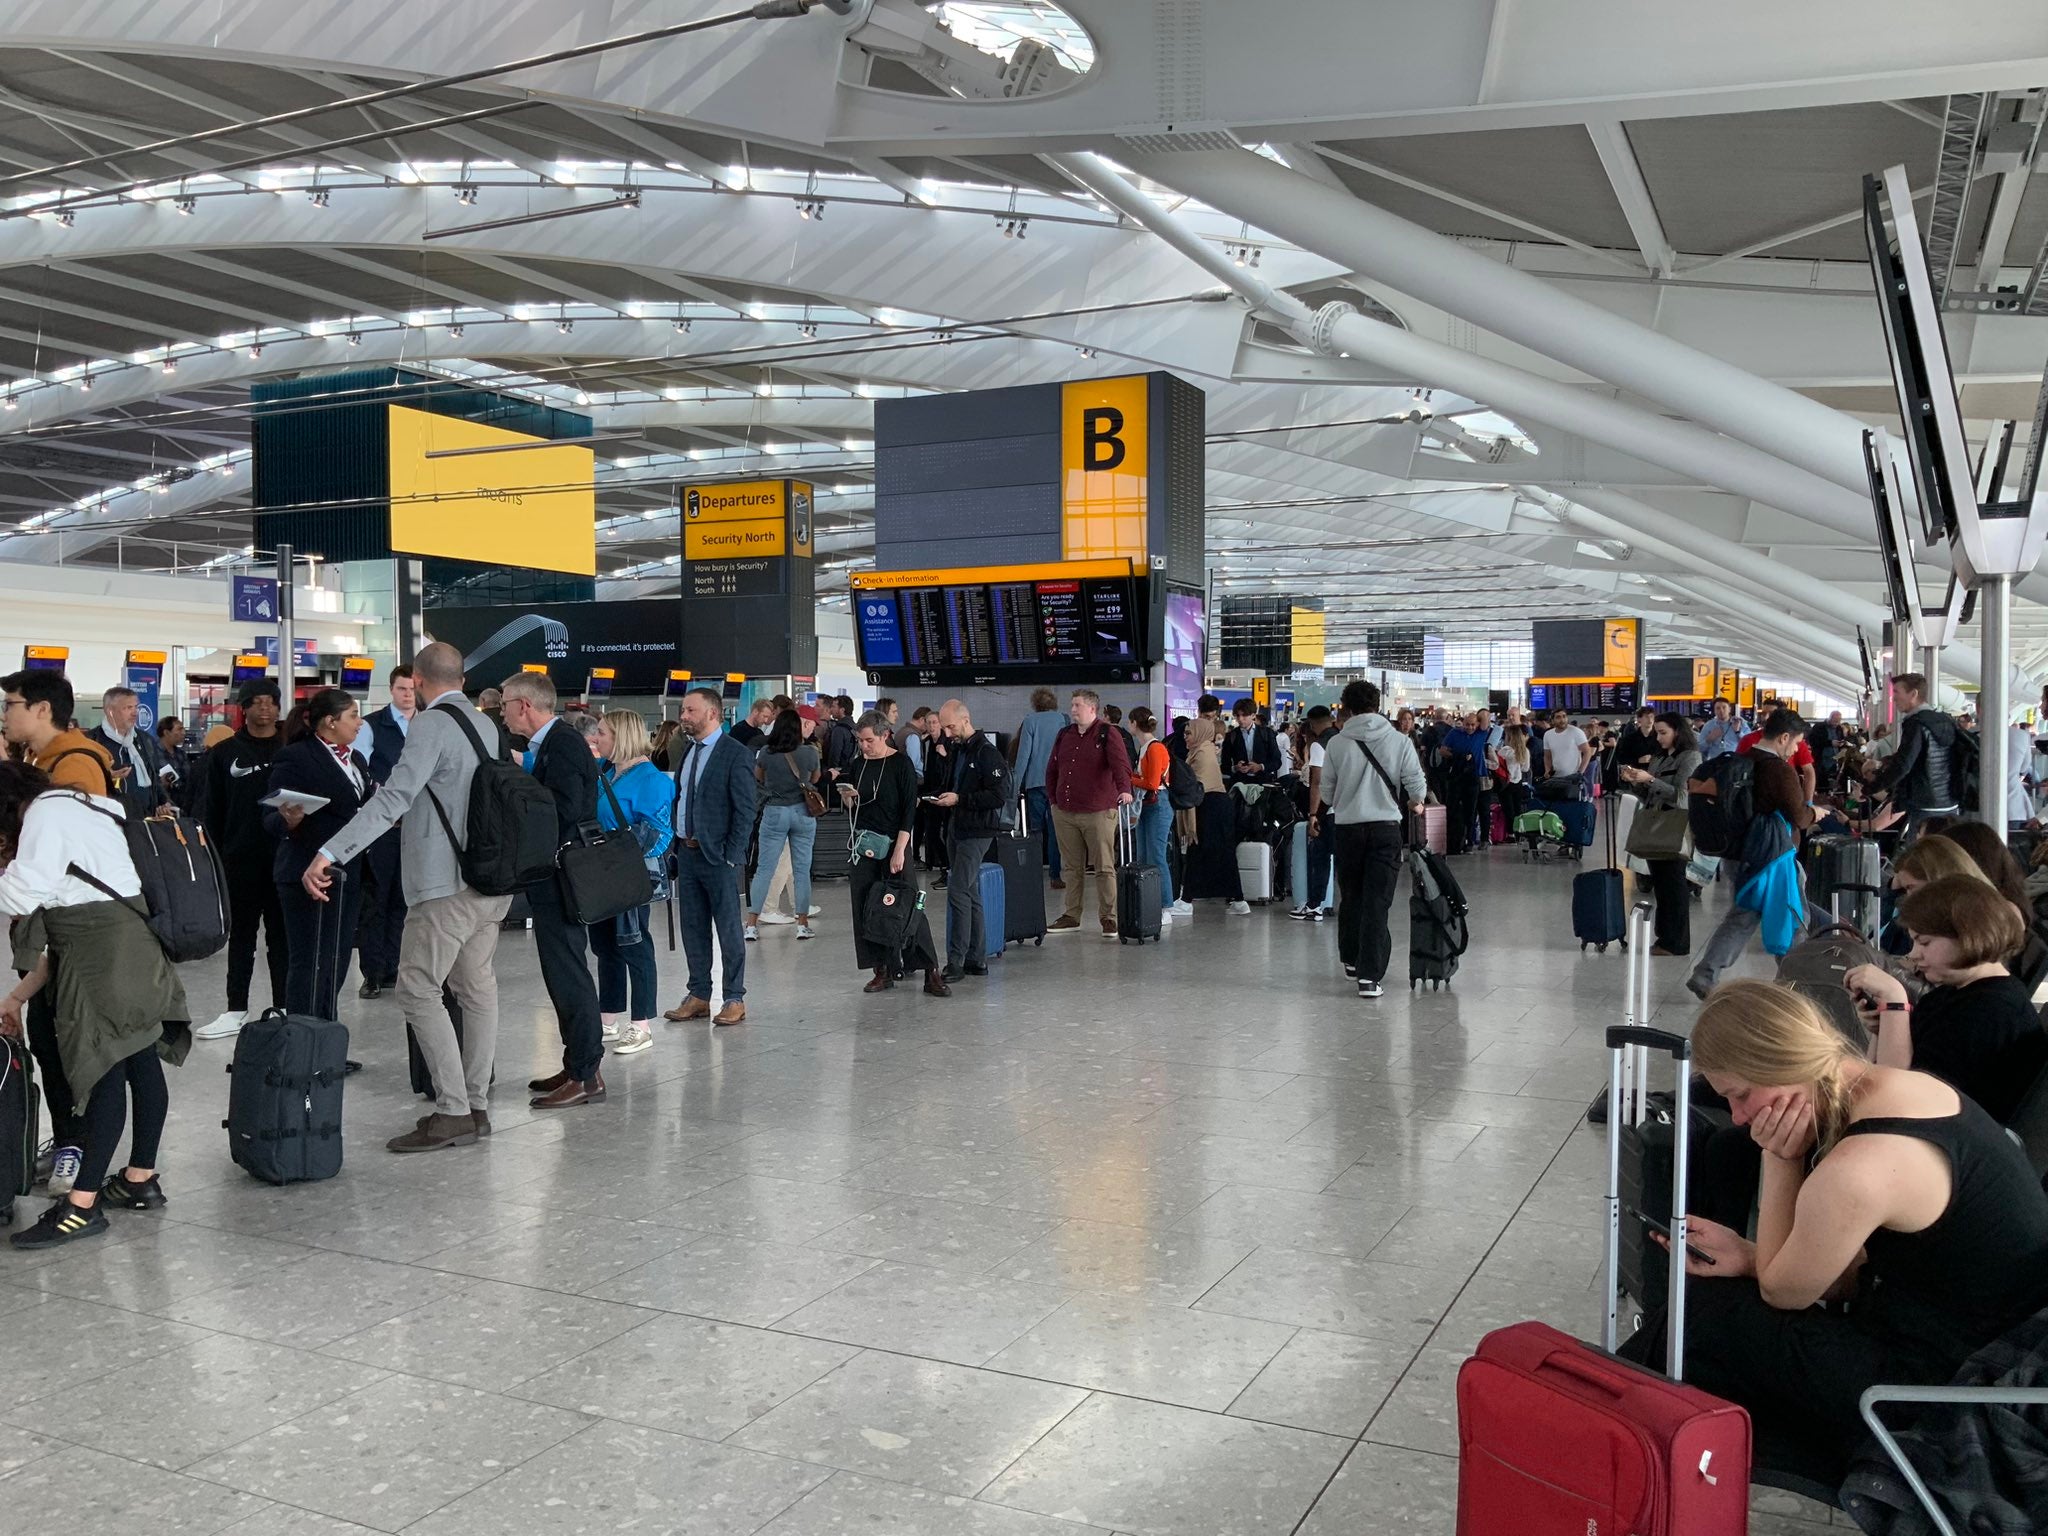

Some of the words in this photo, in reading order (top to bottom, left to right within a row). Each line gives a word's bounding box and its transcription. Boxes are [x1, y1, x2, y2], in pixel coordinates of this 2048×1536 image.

[1083, 407, 1125, 472] B
[702, 494, 776, 510] Departures
[702, 533, 742, 546] Security
[746, 531, 775, 543] North
[694, 564, 711, 572] How
[712, 564, 728, 573] busy
[730, 563, 735, 571] is
[736, 561, 768, 571] Security?
[694, 577, 715, 585] North
[862, 576, 894, 585] Check-in
[895, 574, 940, 583] information
[694, 587, 715, 595] South
[246, 598, 251, 615] 1
[1611, 628, 1628, 648] C
[586, 644, 596, 653] it's
[596, 643, 632, 653] connected,
[632, 643, 642, 651] it's
[642, 642, 676, 652] protected.
[1698, 664, 1710, 677] D
[1723, 674, 1730, 686] E
[1258, 682, 1264, 692] E
